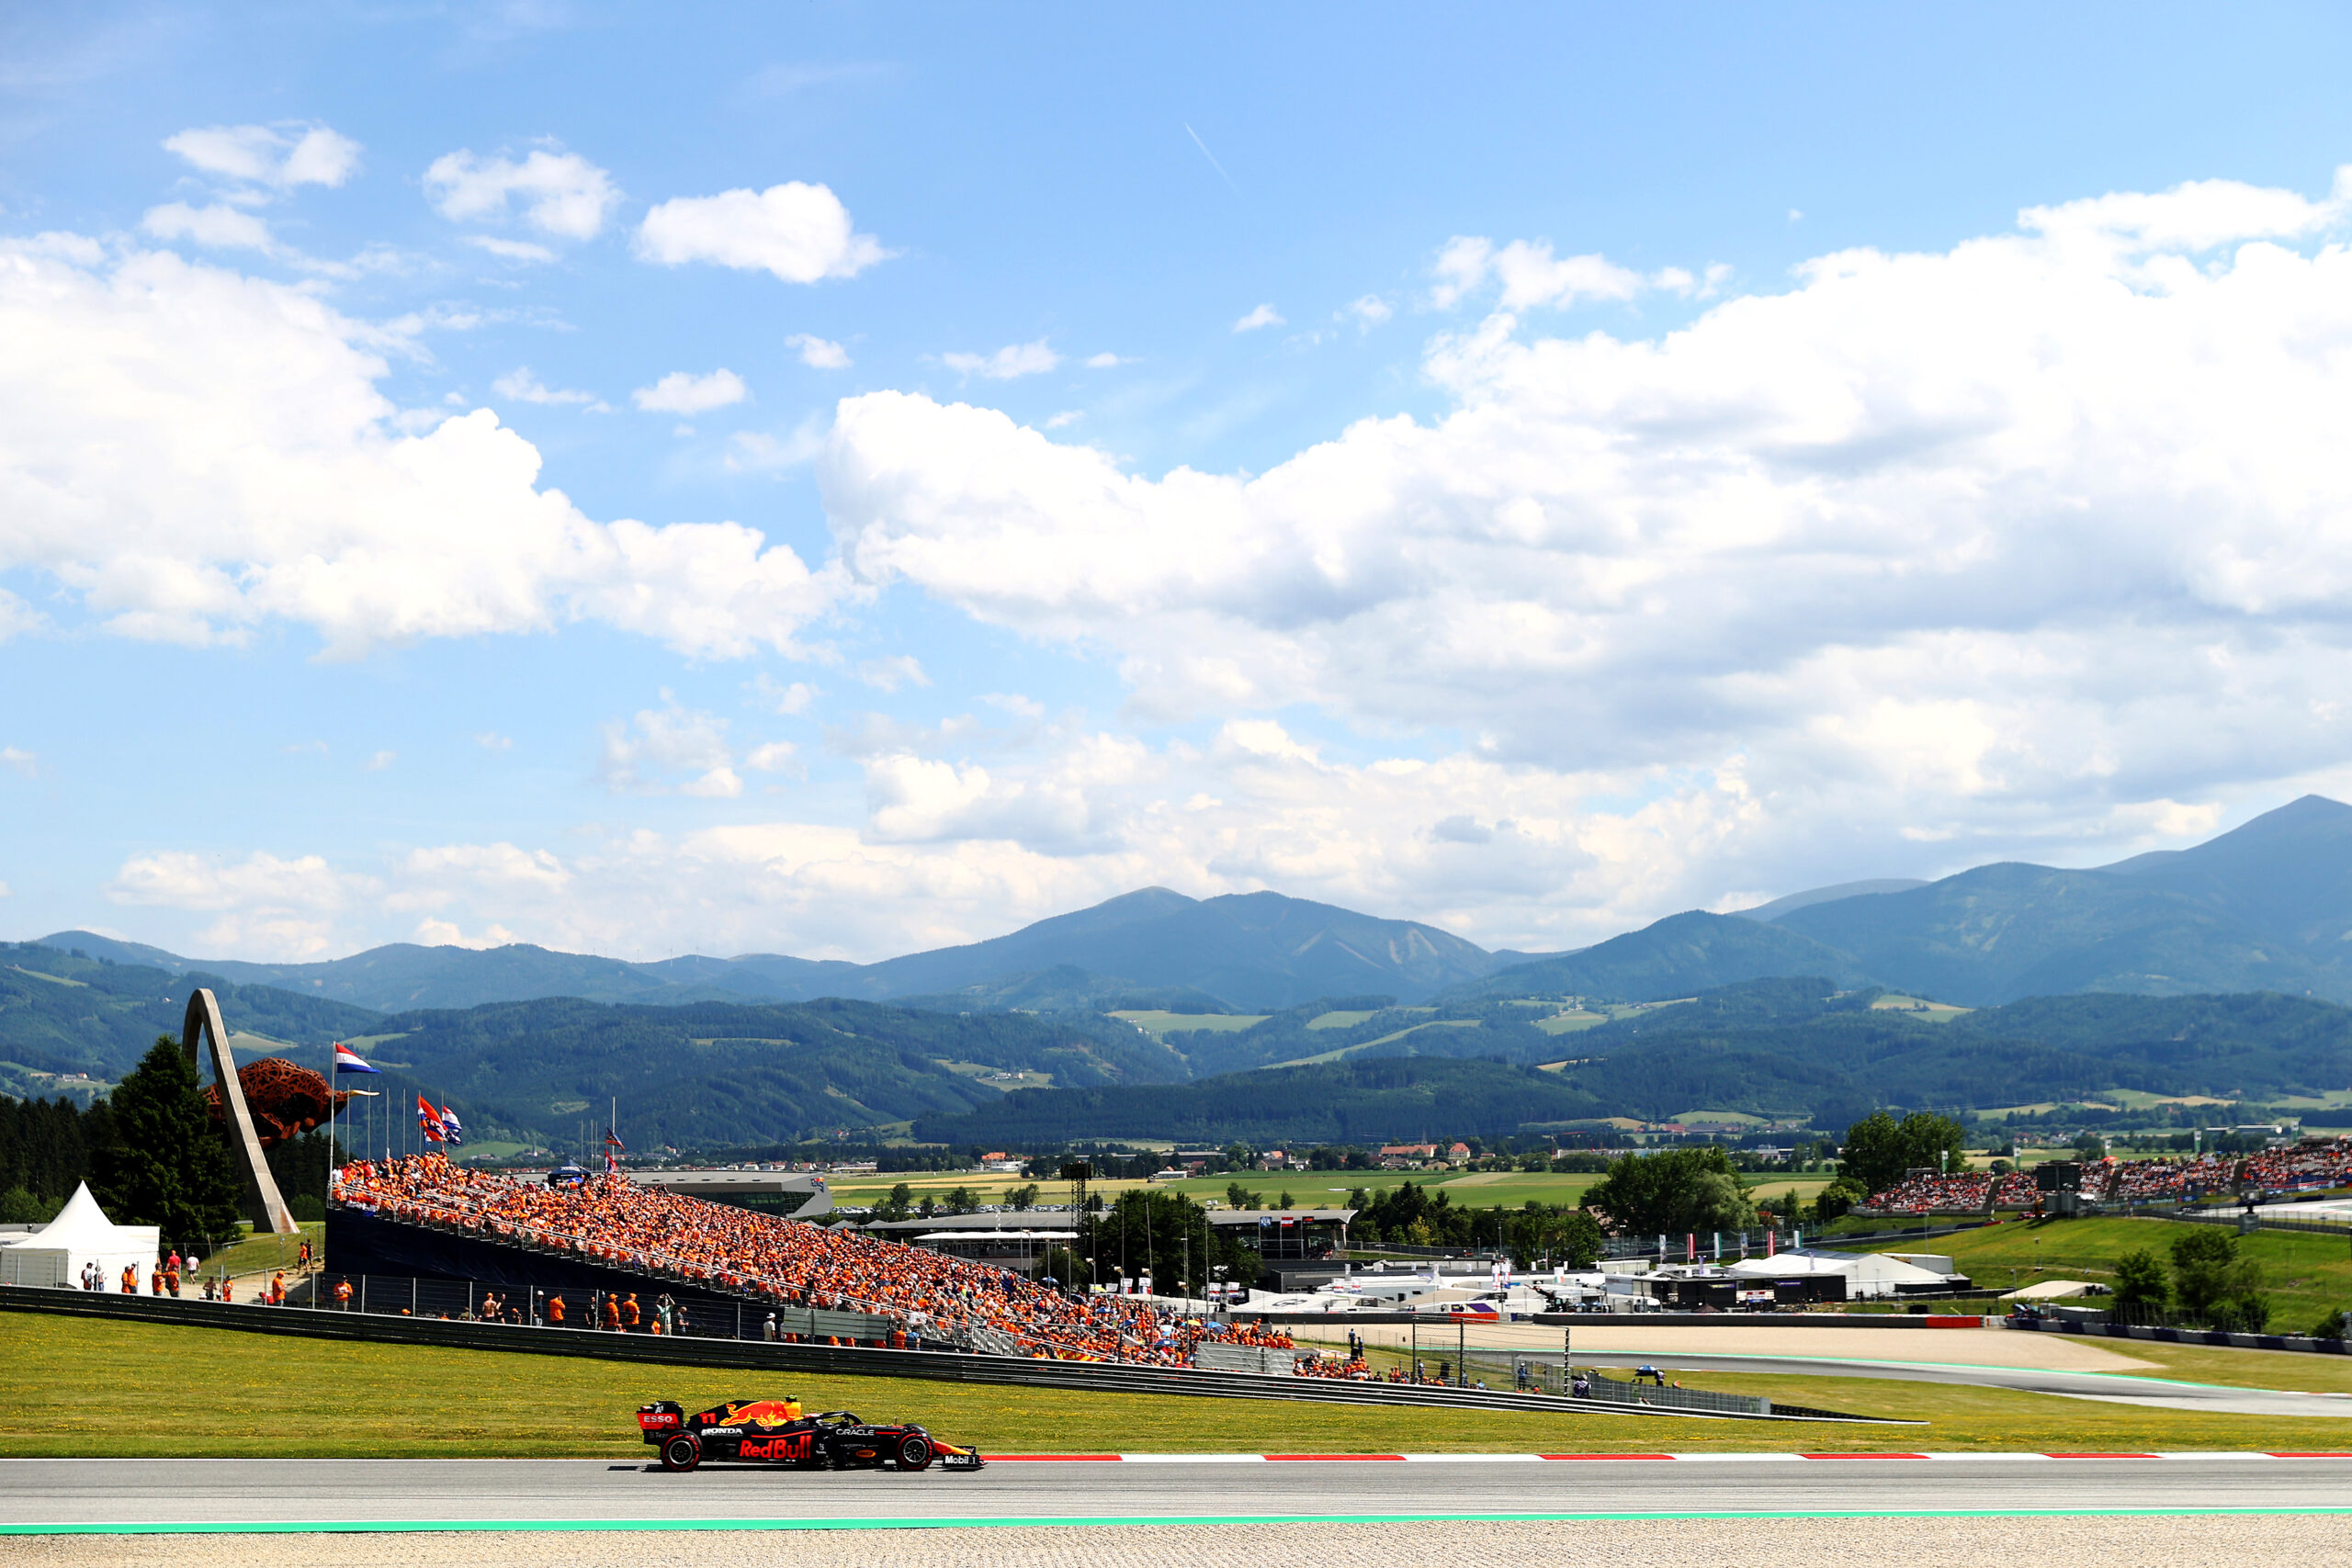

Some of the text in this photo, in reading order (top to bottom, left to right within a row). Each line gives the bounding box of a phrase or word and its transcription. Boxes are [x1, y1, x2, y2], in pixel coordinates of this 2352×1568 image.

[699, 1412, 717, 1424] 11
[701, 1427, 743, 1436] HONDA
[944, 1455, 968, 1464] Mobil
